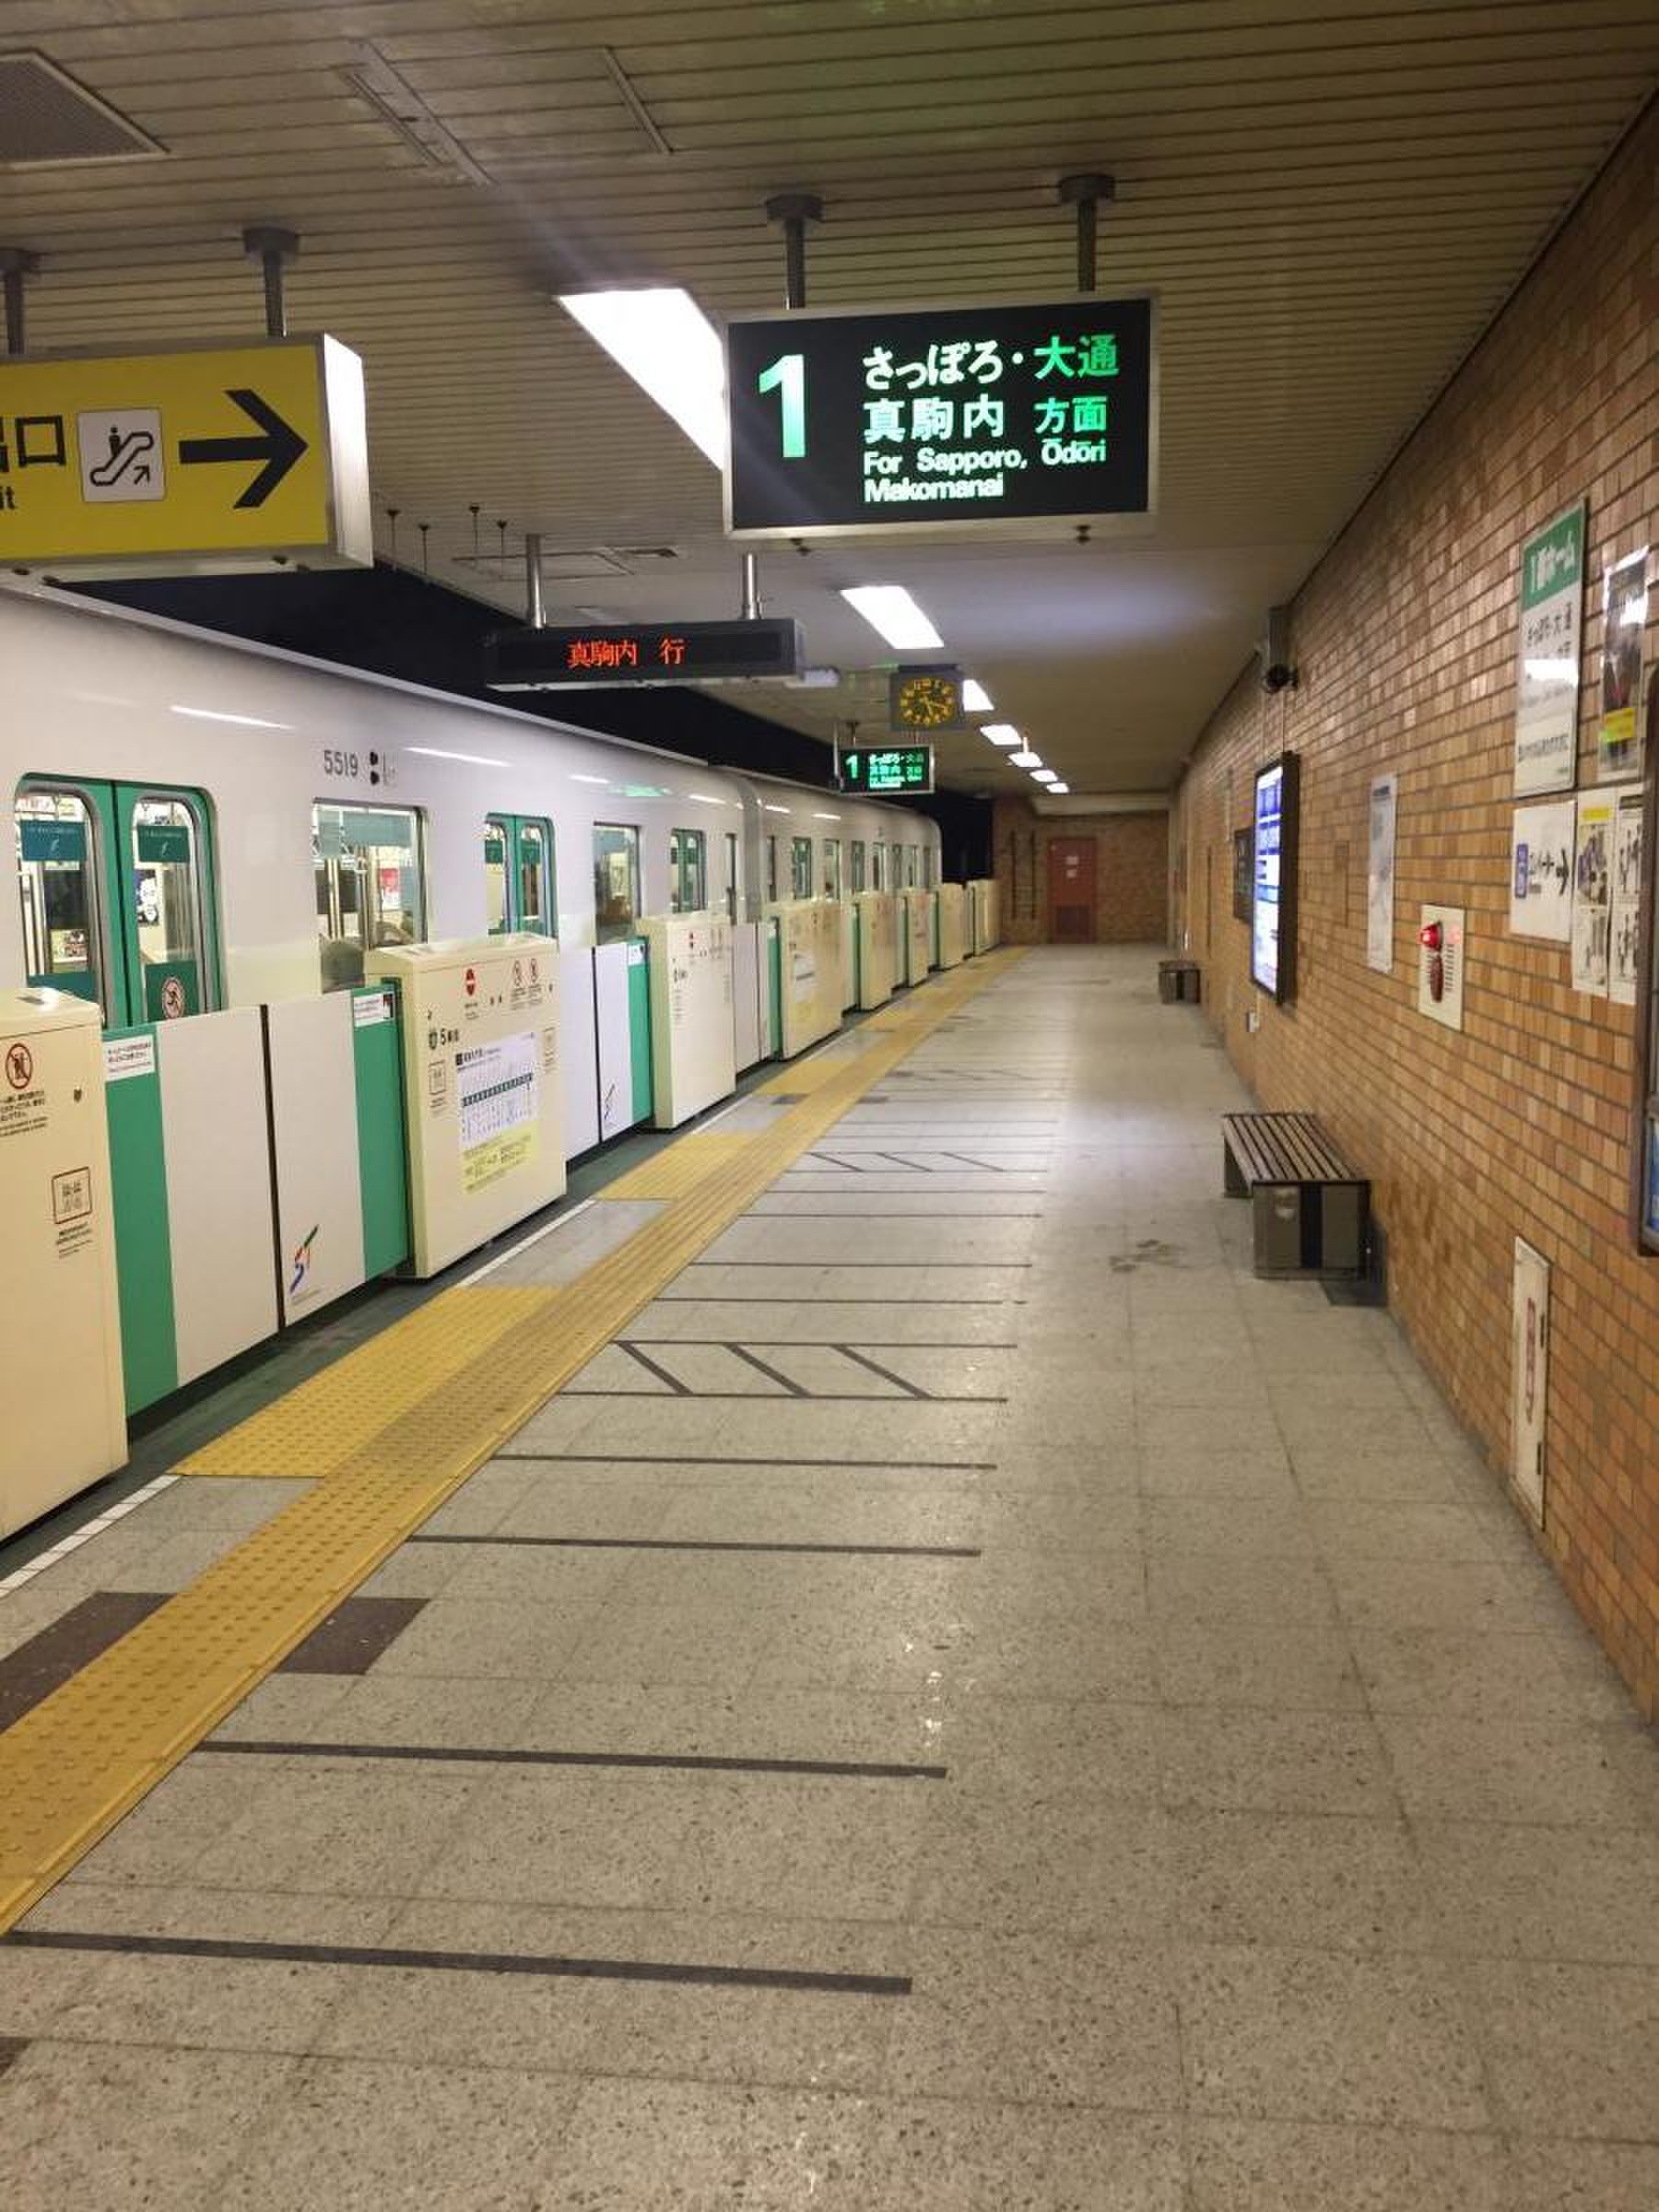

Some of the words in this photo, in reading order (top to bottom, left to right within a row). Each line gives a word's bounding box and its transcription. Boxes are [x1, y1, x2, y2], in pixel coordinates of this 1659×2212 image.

[759, 354, 806, 458] 1
[863, 393, 1004, 443] 真駒内
[1033, 395, 1108, 434] 方面
[864, 451, 902, 476] For
[916, 446, 1029, 476] Sapporo,
[864, 471, 1004, 502] Makomanai
[566, 639, 638, 669] 真駒内
[658, 638, 686, 665] 行
[324, 749, 359, 777] 5519
[845, 754, 858, 779] 1
